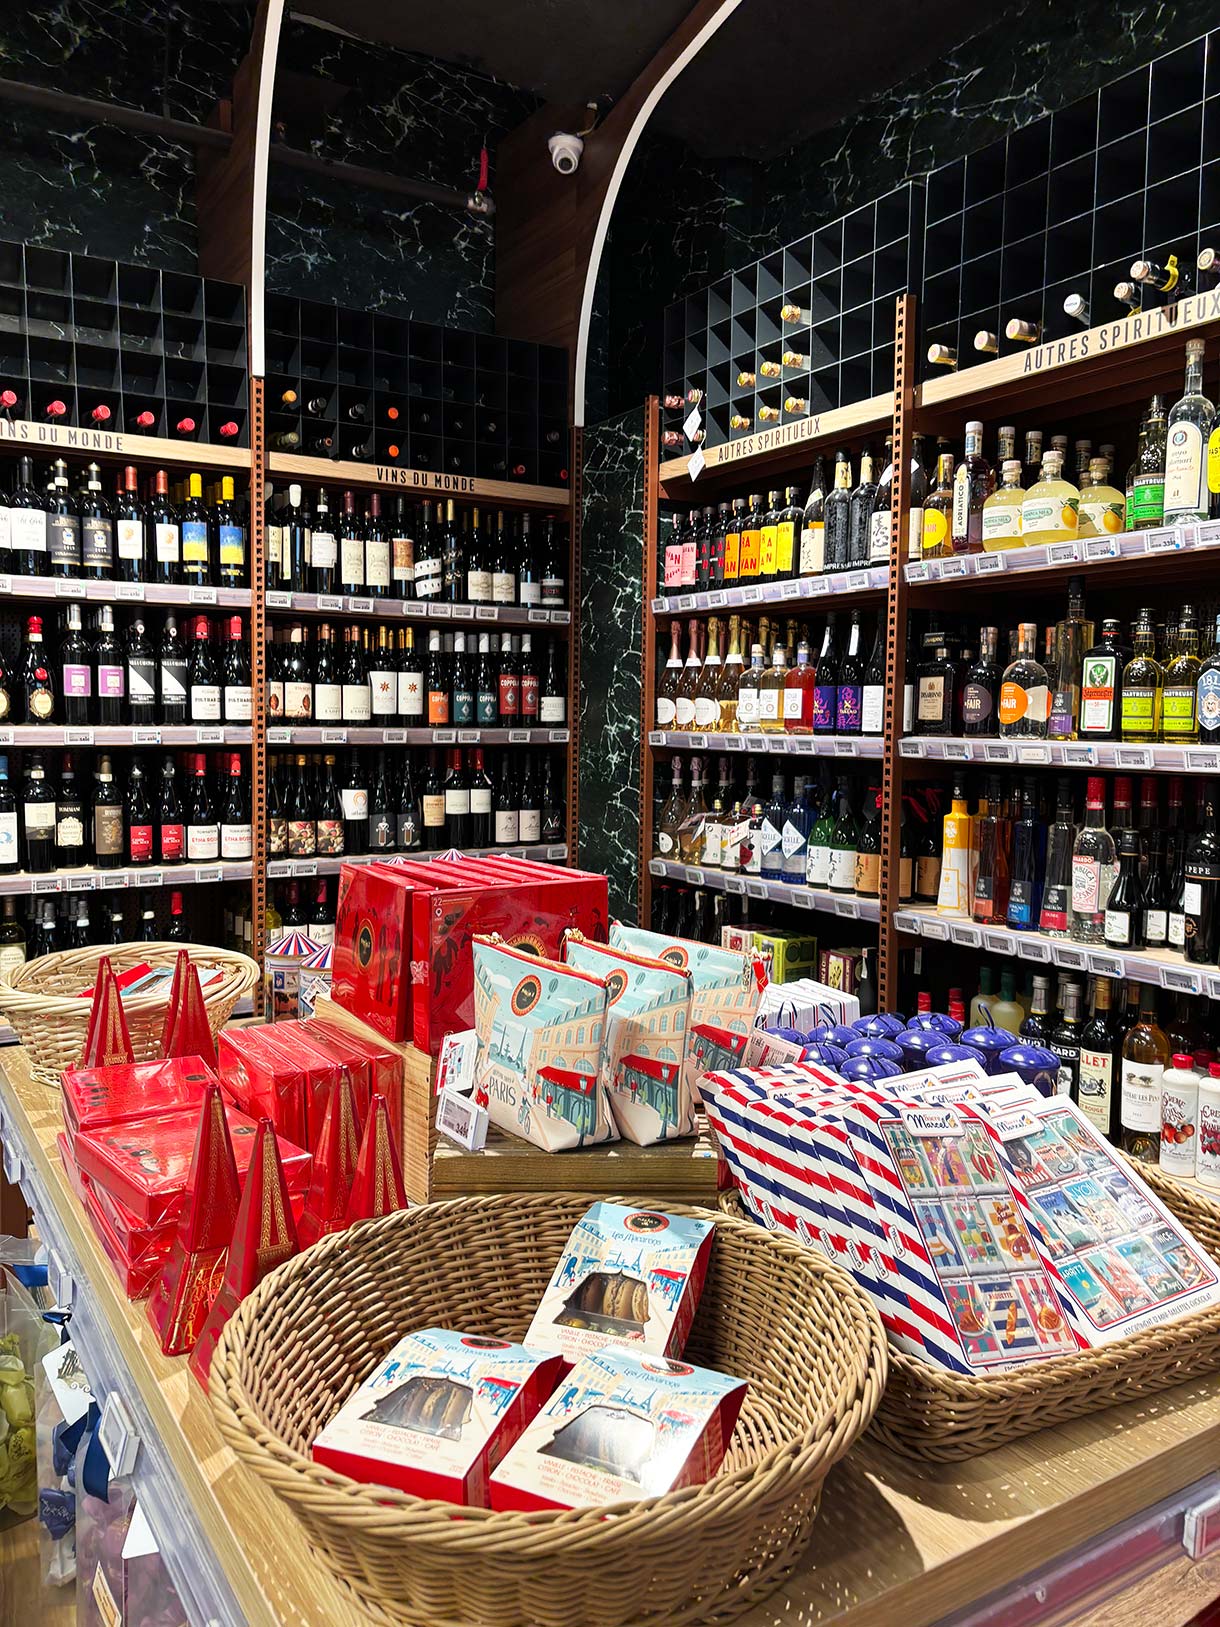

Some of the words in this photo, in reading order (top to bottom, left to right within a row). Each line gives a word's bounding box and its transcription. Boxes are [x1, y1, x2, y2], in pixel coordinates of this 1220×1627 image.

[1024, 335, 1089, 372] AUTRES
[1100, 292, 1220, 350] SPIRITUEUX
[0, 421, 28, 439] INS
[39, 426, 58, 442] DU
[68, 430, 124, 451] MONDE
[718, 438, 754, 462] AUTRES
[758, 417, 820, 450] SPIRITUEUX
[377, 468, 406, 484] VINS
[414, 472, 428, 486] DU
[434, 474, 475, 492] MONDE
[966, 699, 981, 710] FAIR
[1002, 699, 1016, 709] FAIR
[1188, 866, 1211, 875] PEPE
[1082, 1052, 1108, 1068] LLET
[489, 1076, 516, 1106] PARIS
[1085, 1105, 1104, 1114] ROUGE
[906, 1114, 949, 1129] Marcel
[1022, 1172, 1049, 1186] PARIS
[581, 1338, 608, 1348] CHOCOLA
